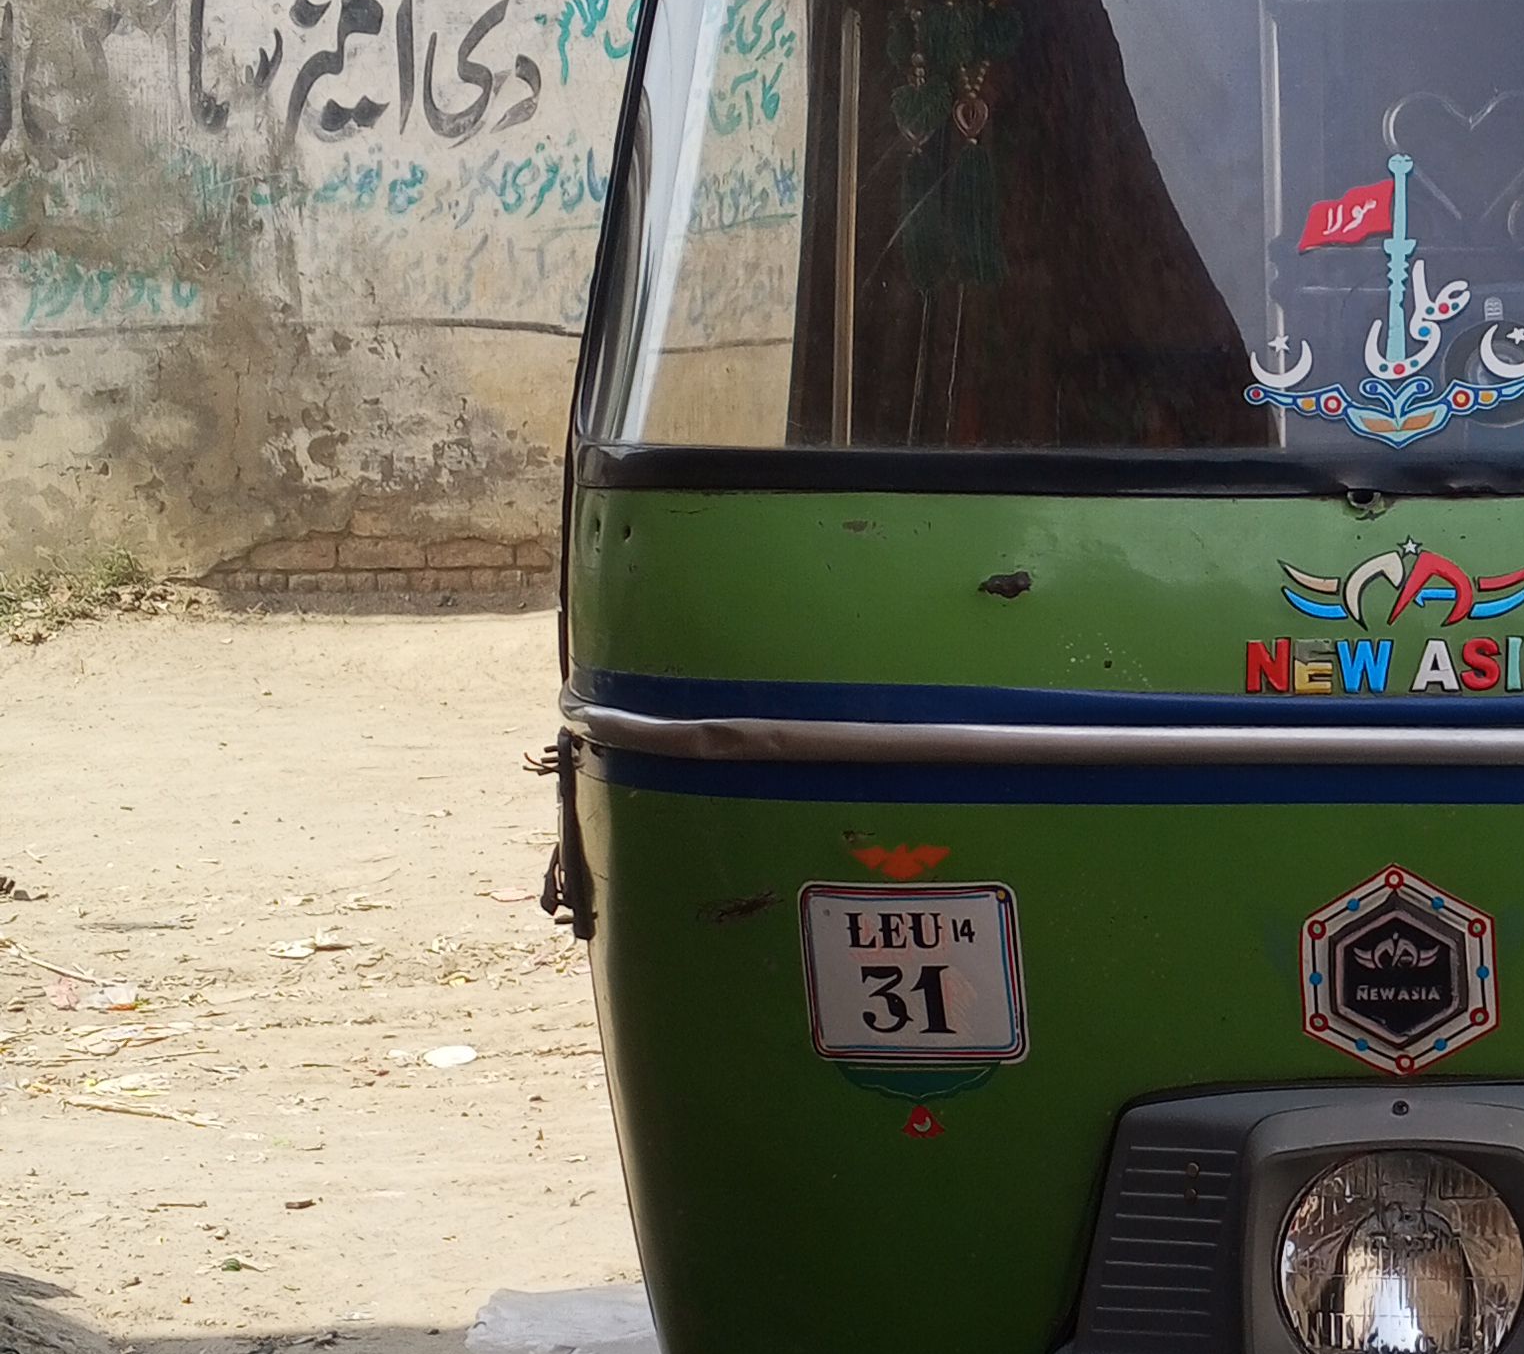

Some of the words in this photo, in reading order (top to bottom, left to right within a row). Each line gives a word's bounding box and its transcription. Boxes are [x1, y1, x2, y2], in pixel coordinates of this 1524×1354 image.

[1364, 258, 1472, 380] علی
[1245, 636, 1394, 695] NEW
[844, 911, 943, 950] LEU
[951, 918, 976, 944] 14
[860, 964, 958, 1035] 31
[1355, 984, 1397, 1002] NEW
[1397, 985, 1442, 1002] ASIA
